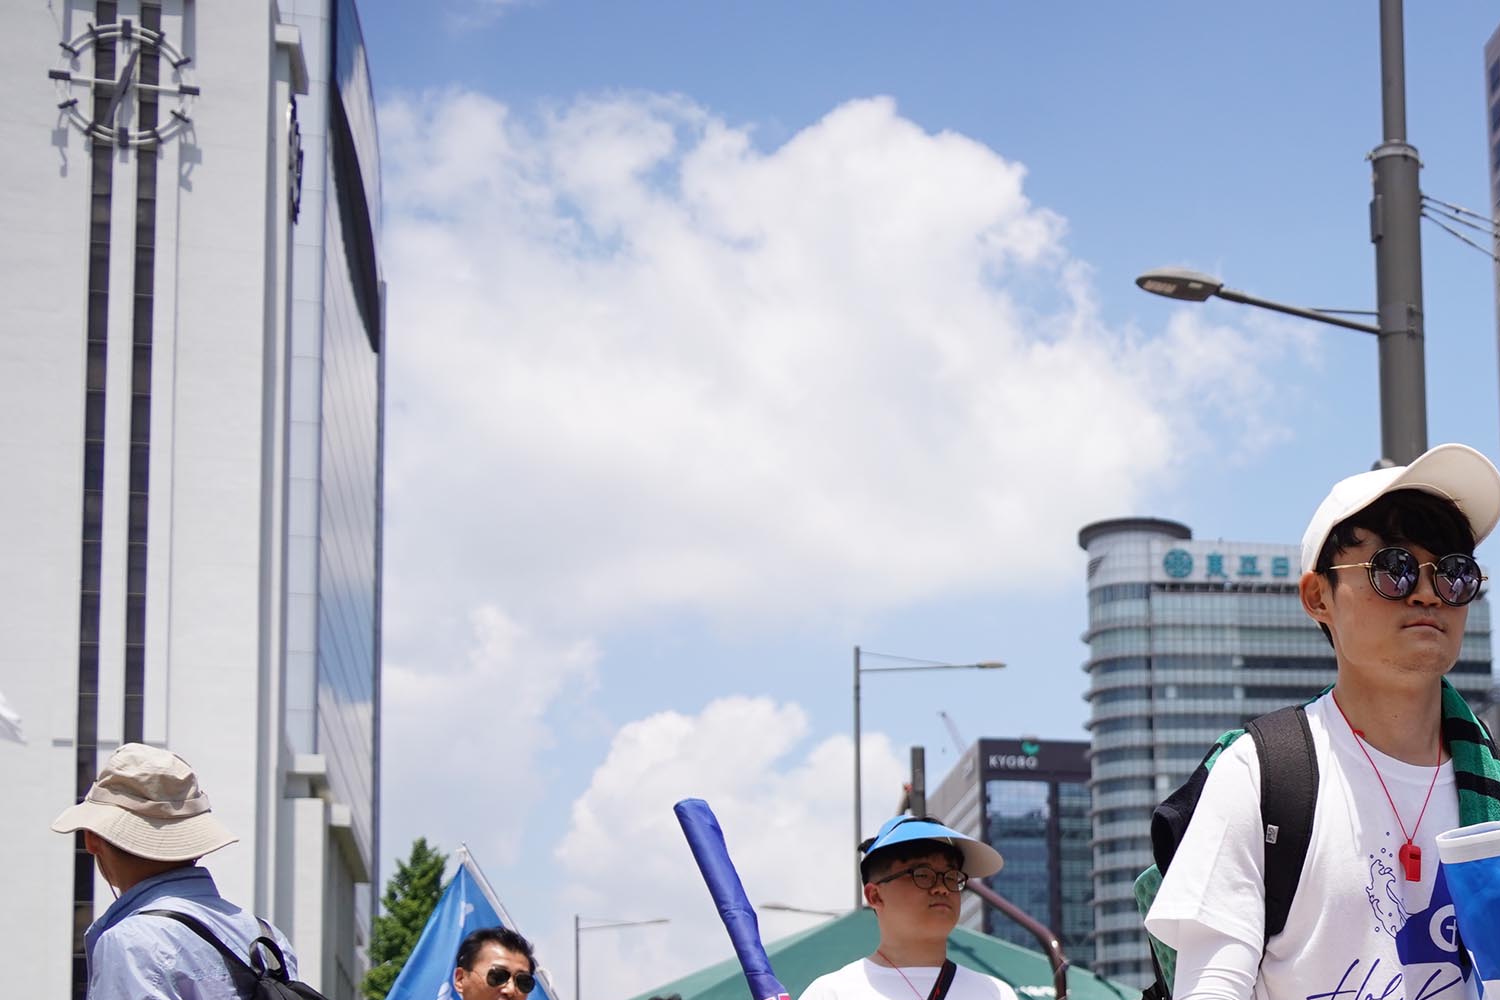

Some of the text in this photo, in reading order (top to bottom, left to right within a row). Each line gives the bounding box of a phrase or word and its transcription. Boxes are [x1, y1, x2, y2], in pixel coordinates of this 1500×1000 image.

[1205, 552, 1291, 579] 東亞日
[988, 754, 1039, 770] KYOBO
